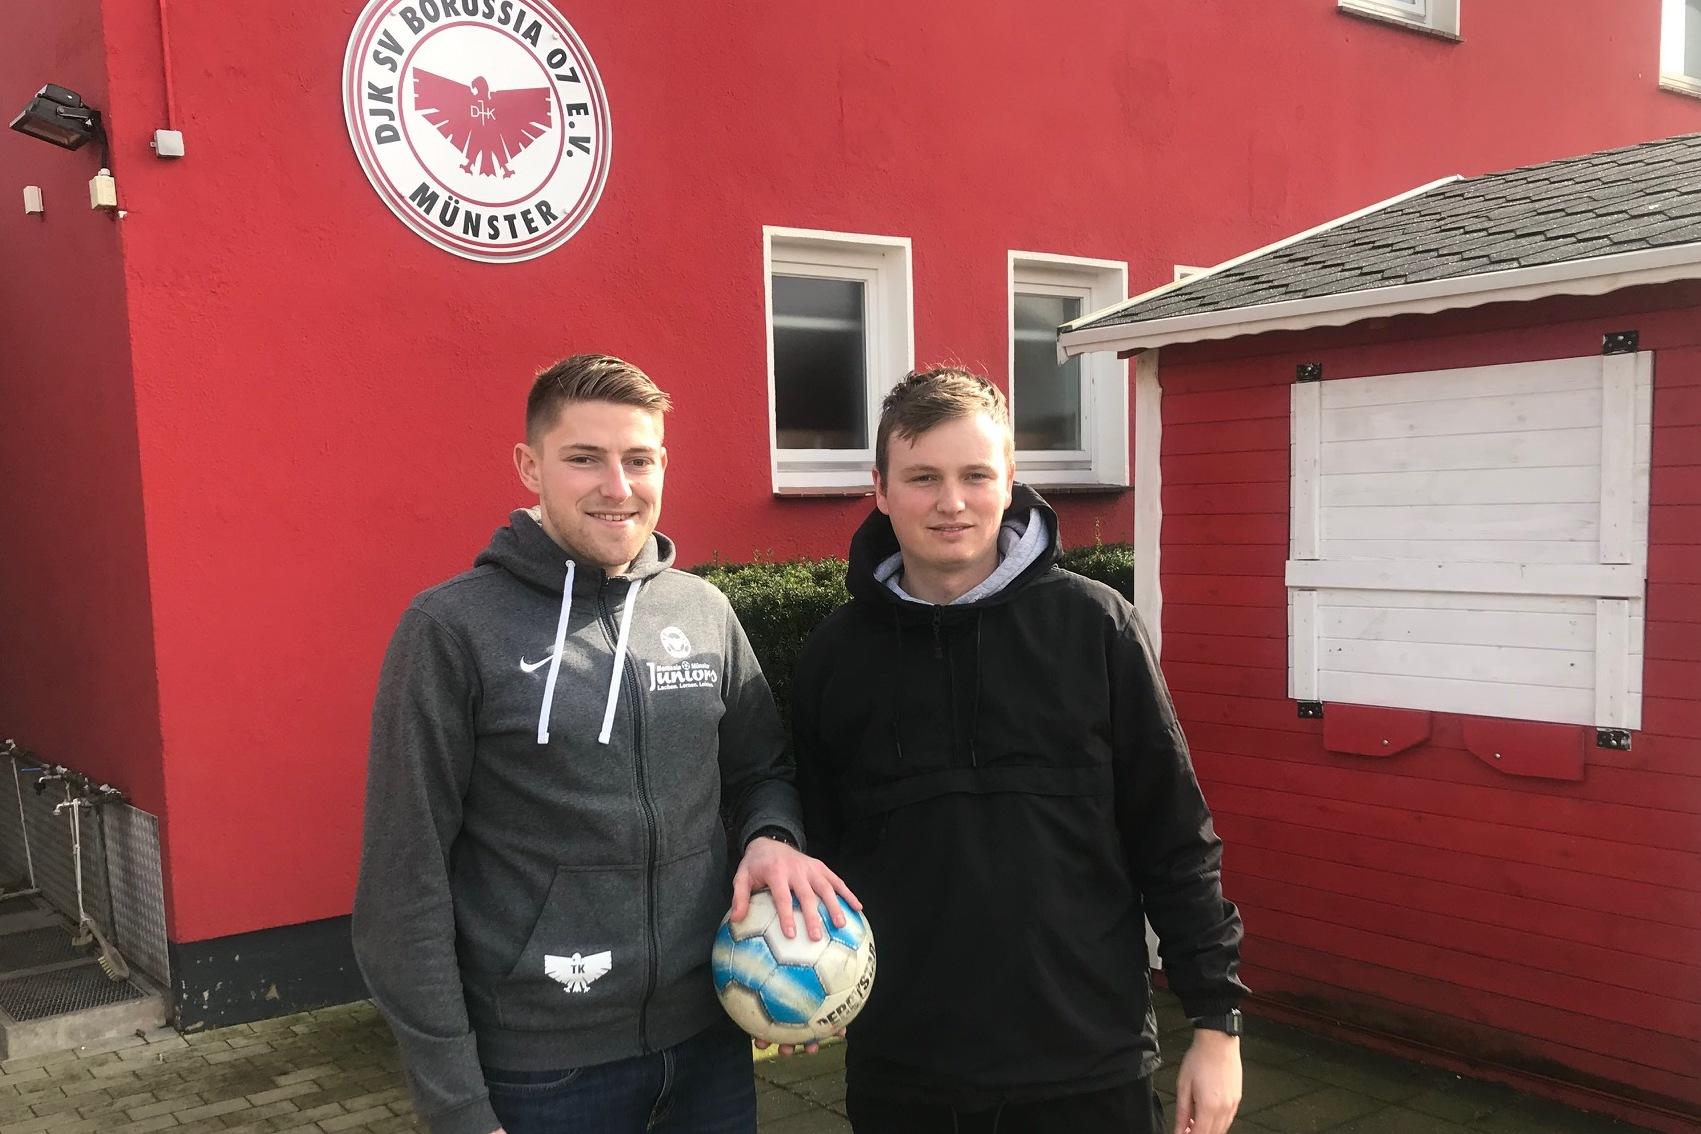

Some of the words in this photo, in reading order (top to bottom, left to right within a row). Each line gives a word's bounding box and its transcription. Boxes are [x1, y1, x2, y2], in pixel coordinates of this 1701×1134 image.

[399, 0, 542, 47] BORUSSIA
[372, 28, 404, 73] SV
[546, 48, 581, 84] 07
[368, 80, 401, 145] DJK
[566, 102, 591, 157] E.V.
[409, 182, 559, 240] MÜNSTER
[646, 662, 718, 691] Juniors
[571, 964, 585, 974] TK
